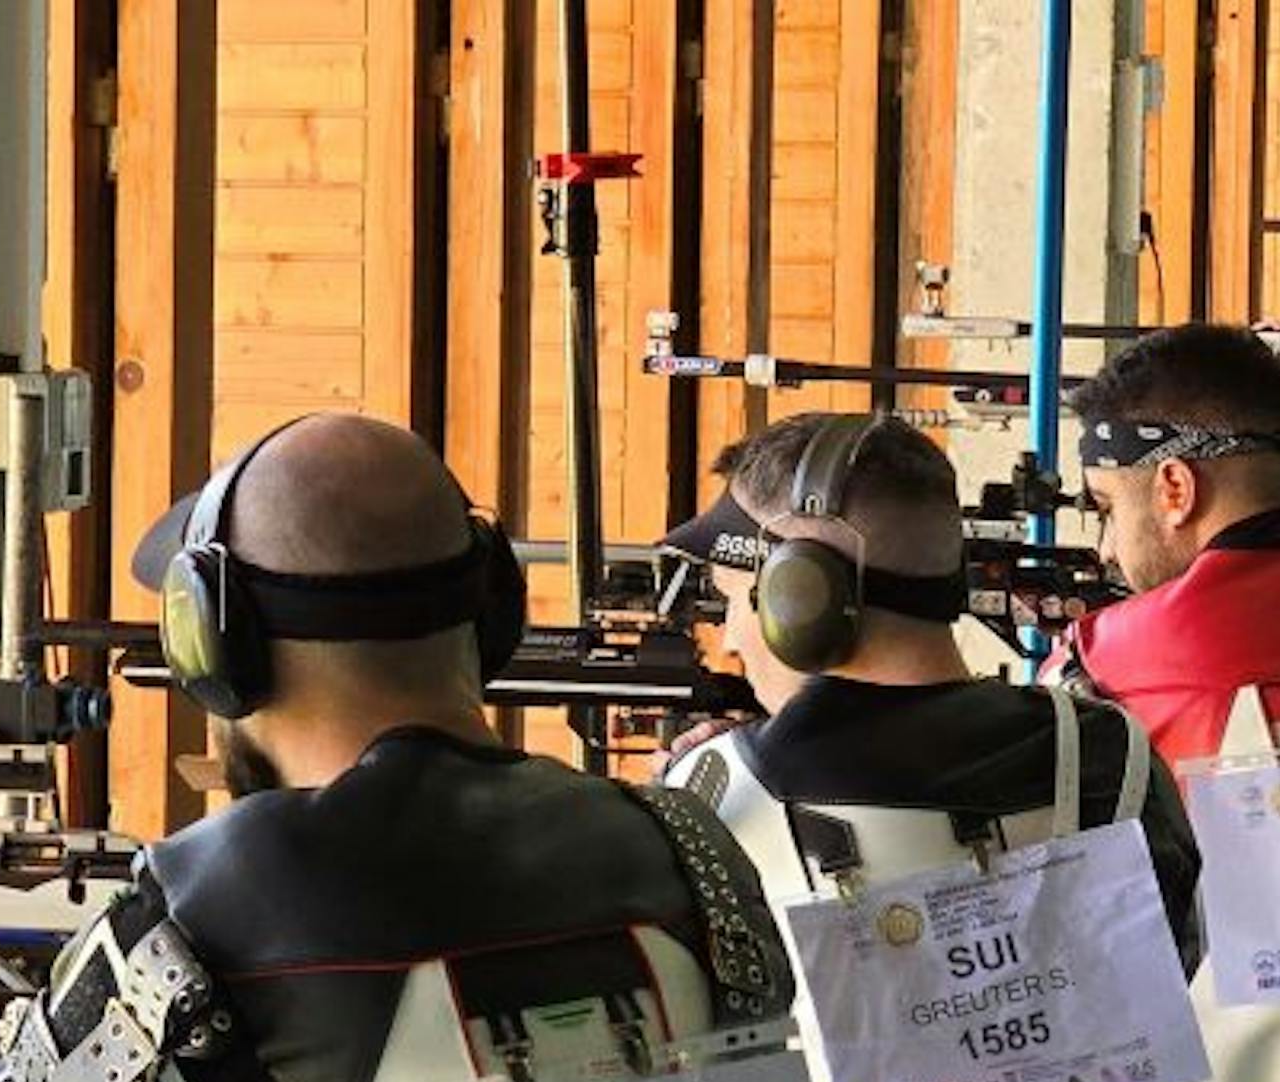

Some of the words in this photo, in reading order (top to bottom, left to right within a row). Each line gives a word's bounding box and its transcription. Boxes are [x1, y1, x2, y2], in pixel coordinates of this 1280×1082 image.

[946, 932, 1020, 980] SUI
[910, 976, 1041, 1026] GREUTER
[1048, 967, 1077, 992] S.
[959, 1011, 1051, 1061] 1585
